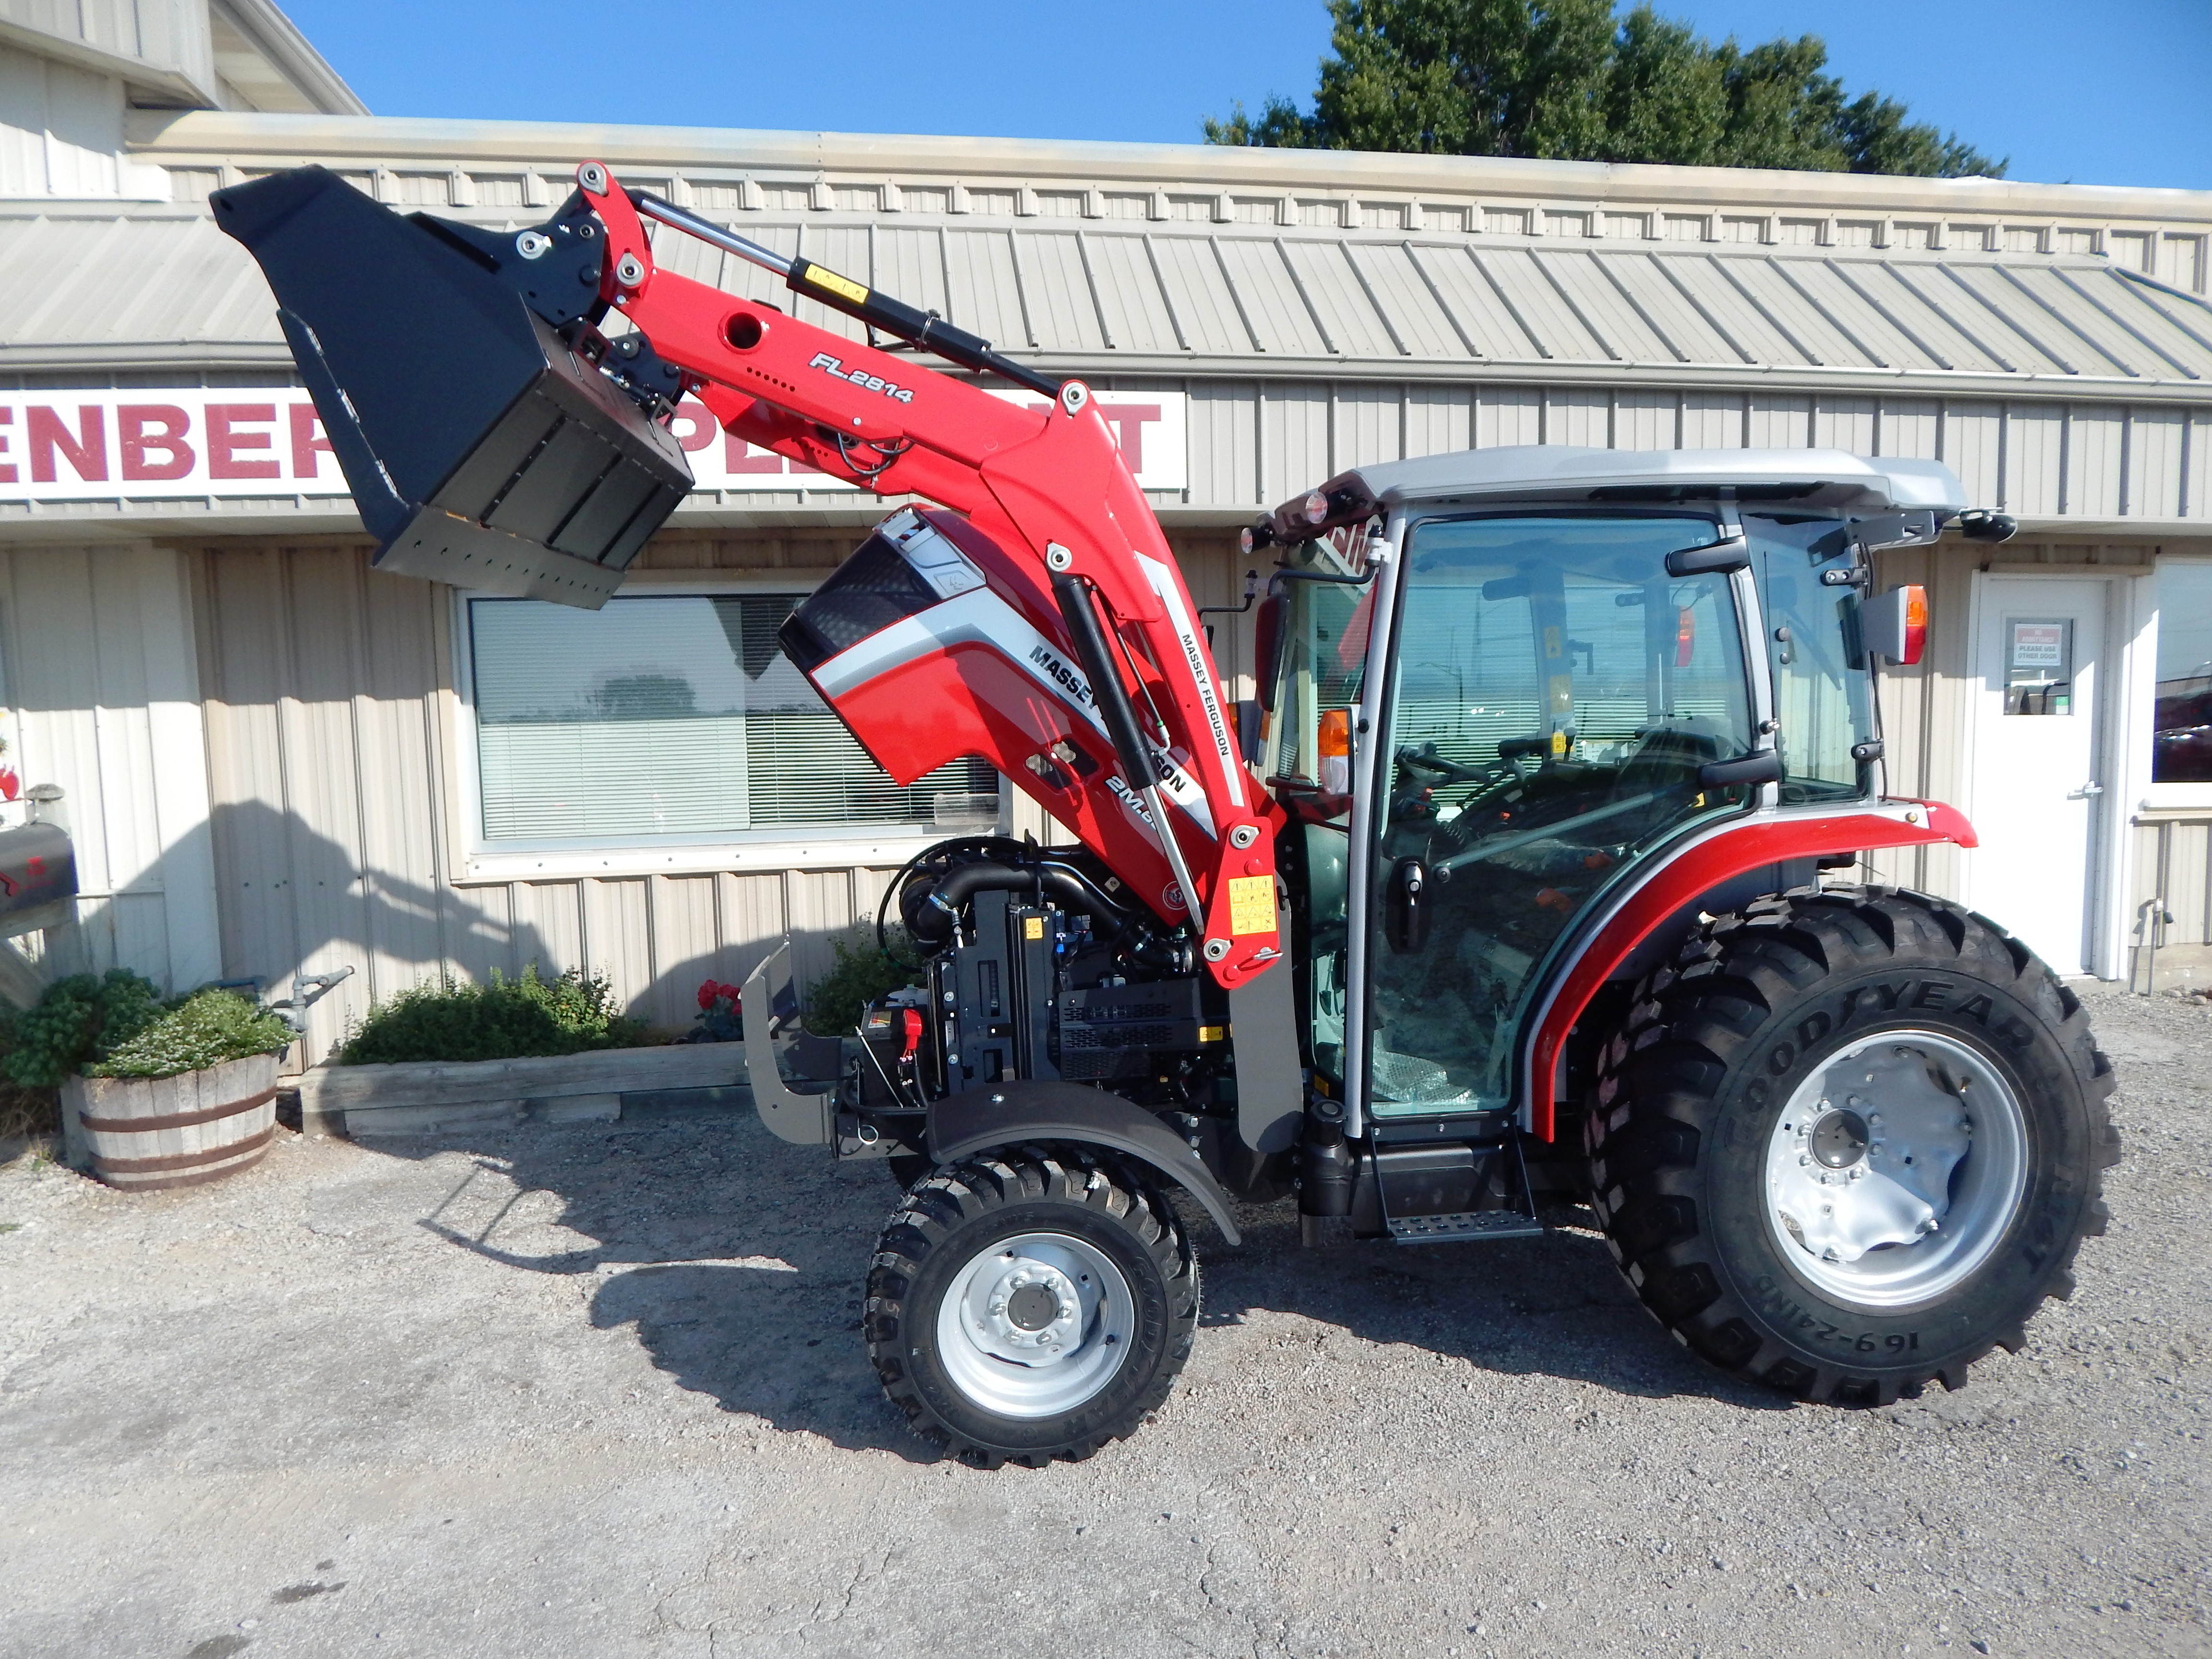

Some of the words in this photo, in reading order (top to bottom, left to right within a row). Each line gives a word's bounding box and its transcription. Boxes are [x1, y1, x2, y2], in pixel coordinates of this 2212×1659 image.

[808, 351, 915, 403] FL.2814
[1182, 634, 1207, 685] MASSEY
[1202, 689, 1229, 756] FERGUSON
[1105, 775, 1157, 830] 2M.6
[1725, 979, 2035, 1159] GOODYEAR
